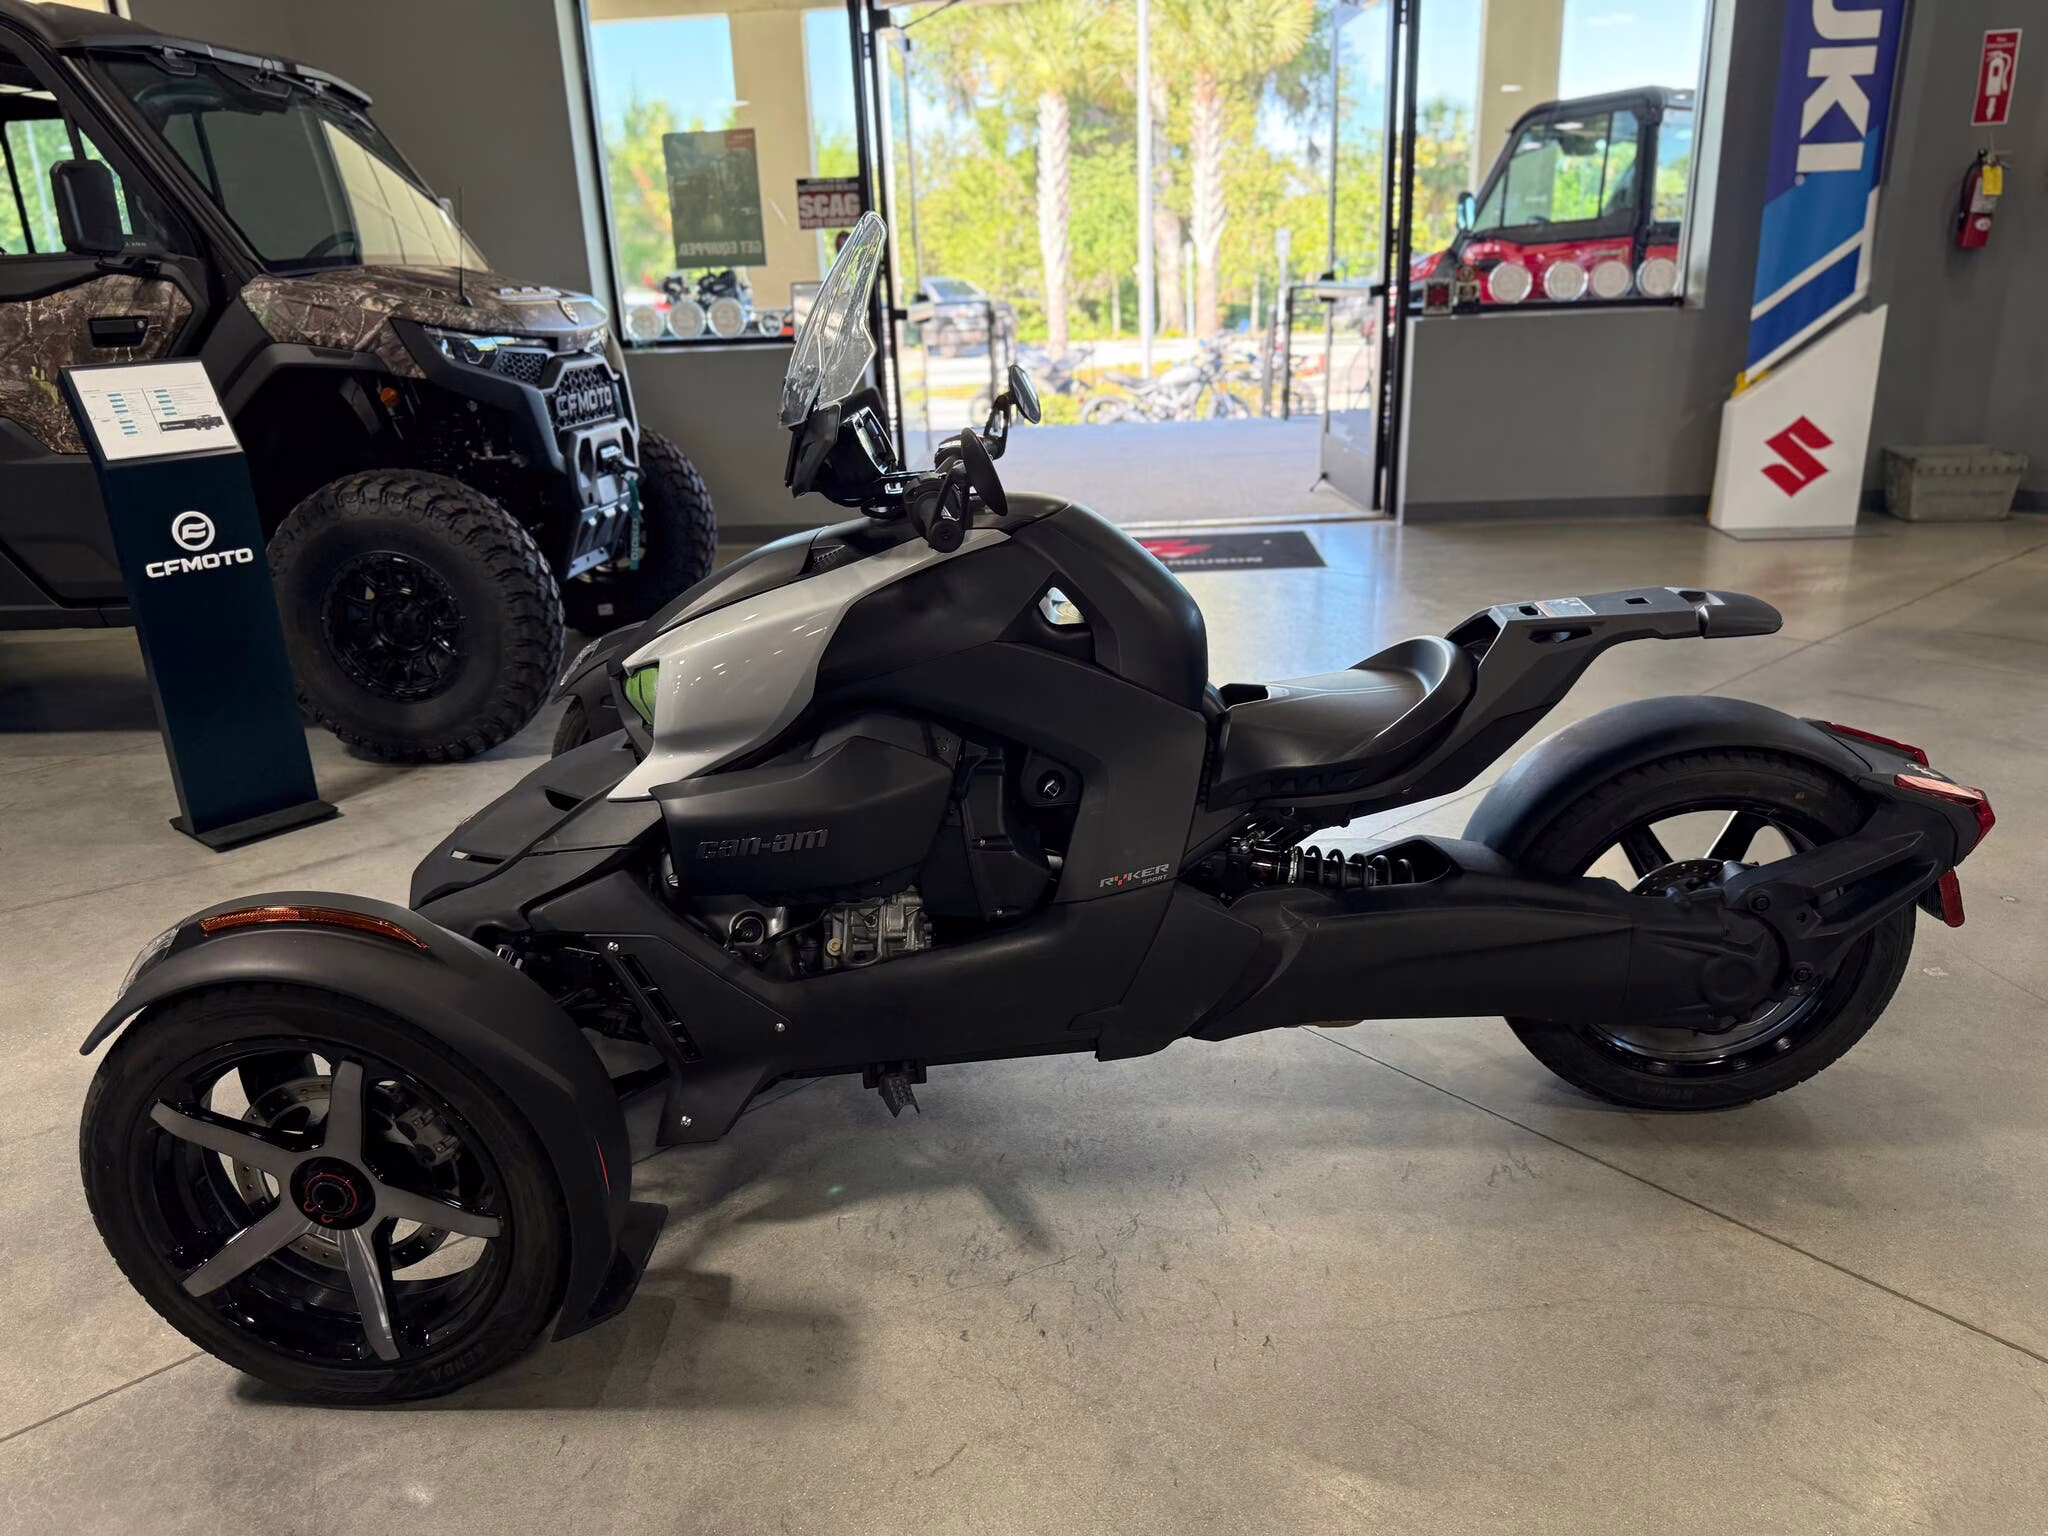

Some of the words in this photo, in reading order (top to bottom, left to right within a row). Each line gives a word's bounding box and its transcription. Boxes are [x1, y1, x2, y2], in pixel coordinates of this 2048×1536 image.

[799, 192, 861, 218] SCAG
[556, 386, 613, 418] CFMOTO
[146, 547, 254, 578] CFMOTO
[696, 829, 829, 859] can-am
[1100, 863, 1170, 888] RYKER
[1142, 874, 1168, 885] SPORT
